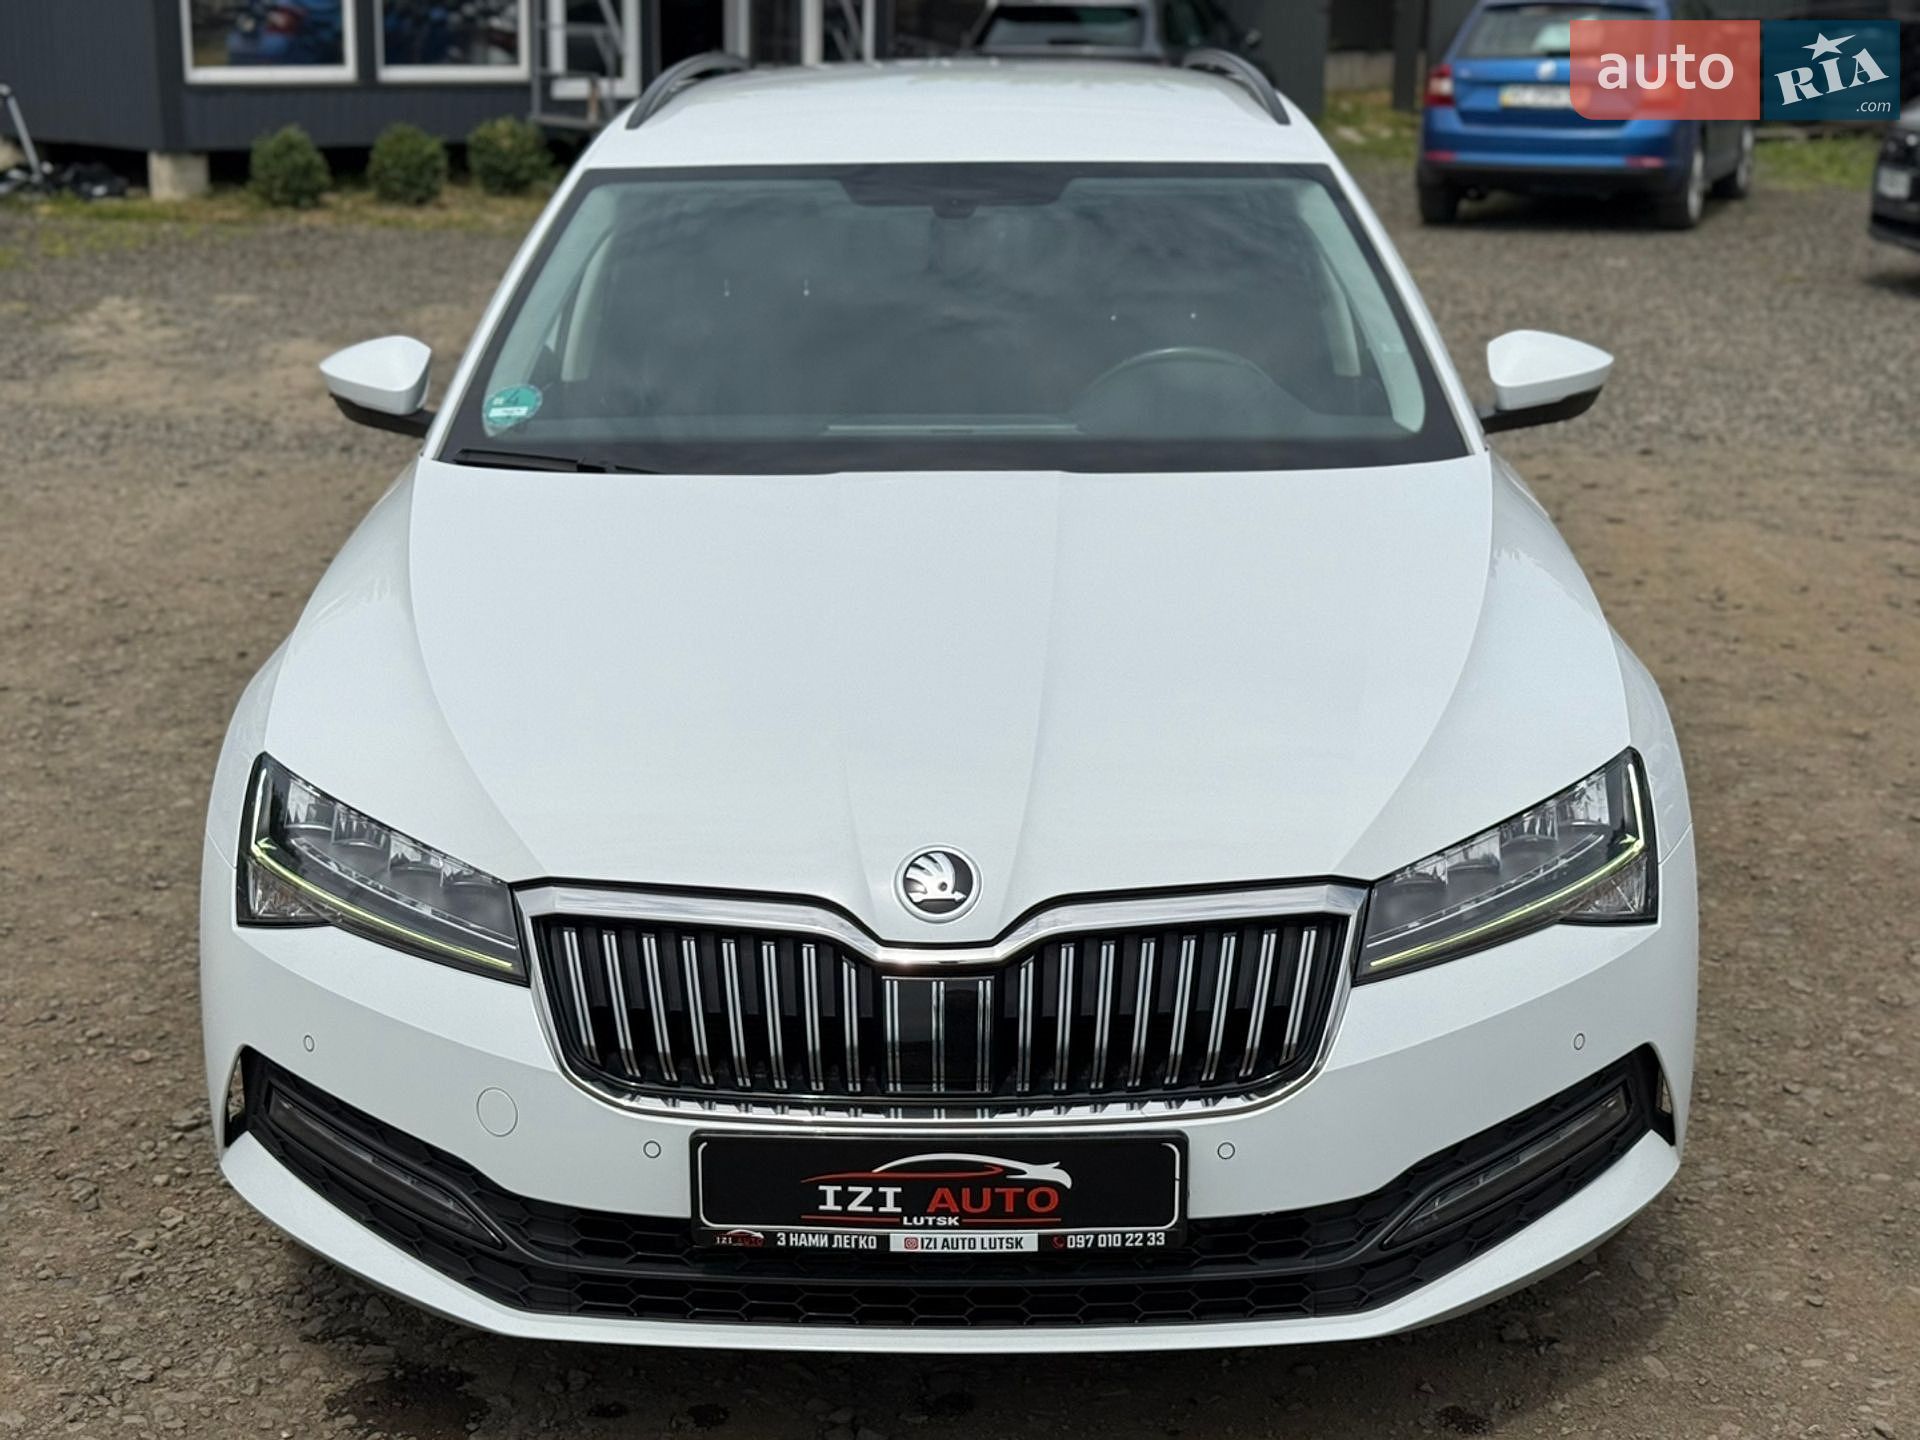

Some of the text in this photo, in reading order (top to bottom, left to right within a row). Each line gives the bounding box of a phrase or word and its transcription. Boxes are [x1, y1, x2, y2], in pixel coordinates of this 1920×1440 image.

[818, 1185, 1060, 1213] IZI AUTO
[903, 1216, 959, 1226] LUTSK
[790, 1233, 828, 1248] НАМИ
[832, 1234, 877, 1249] ЛЕГКО
[920, 1237, 1024, 1250] IZI AUTO LUTSK
[1067, 1232, 1165, 1248] 097 010 22 33
